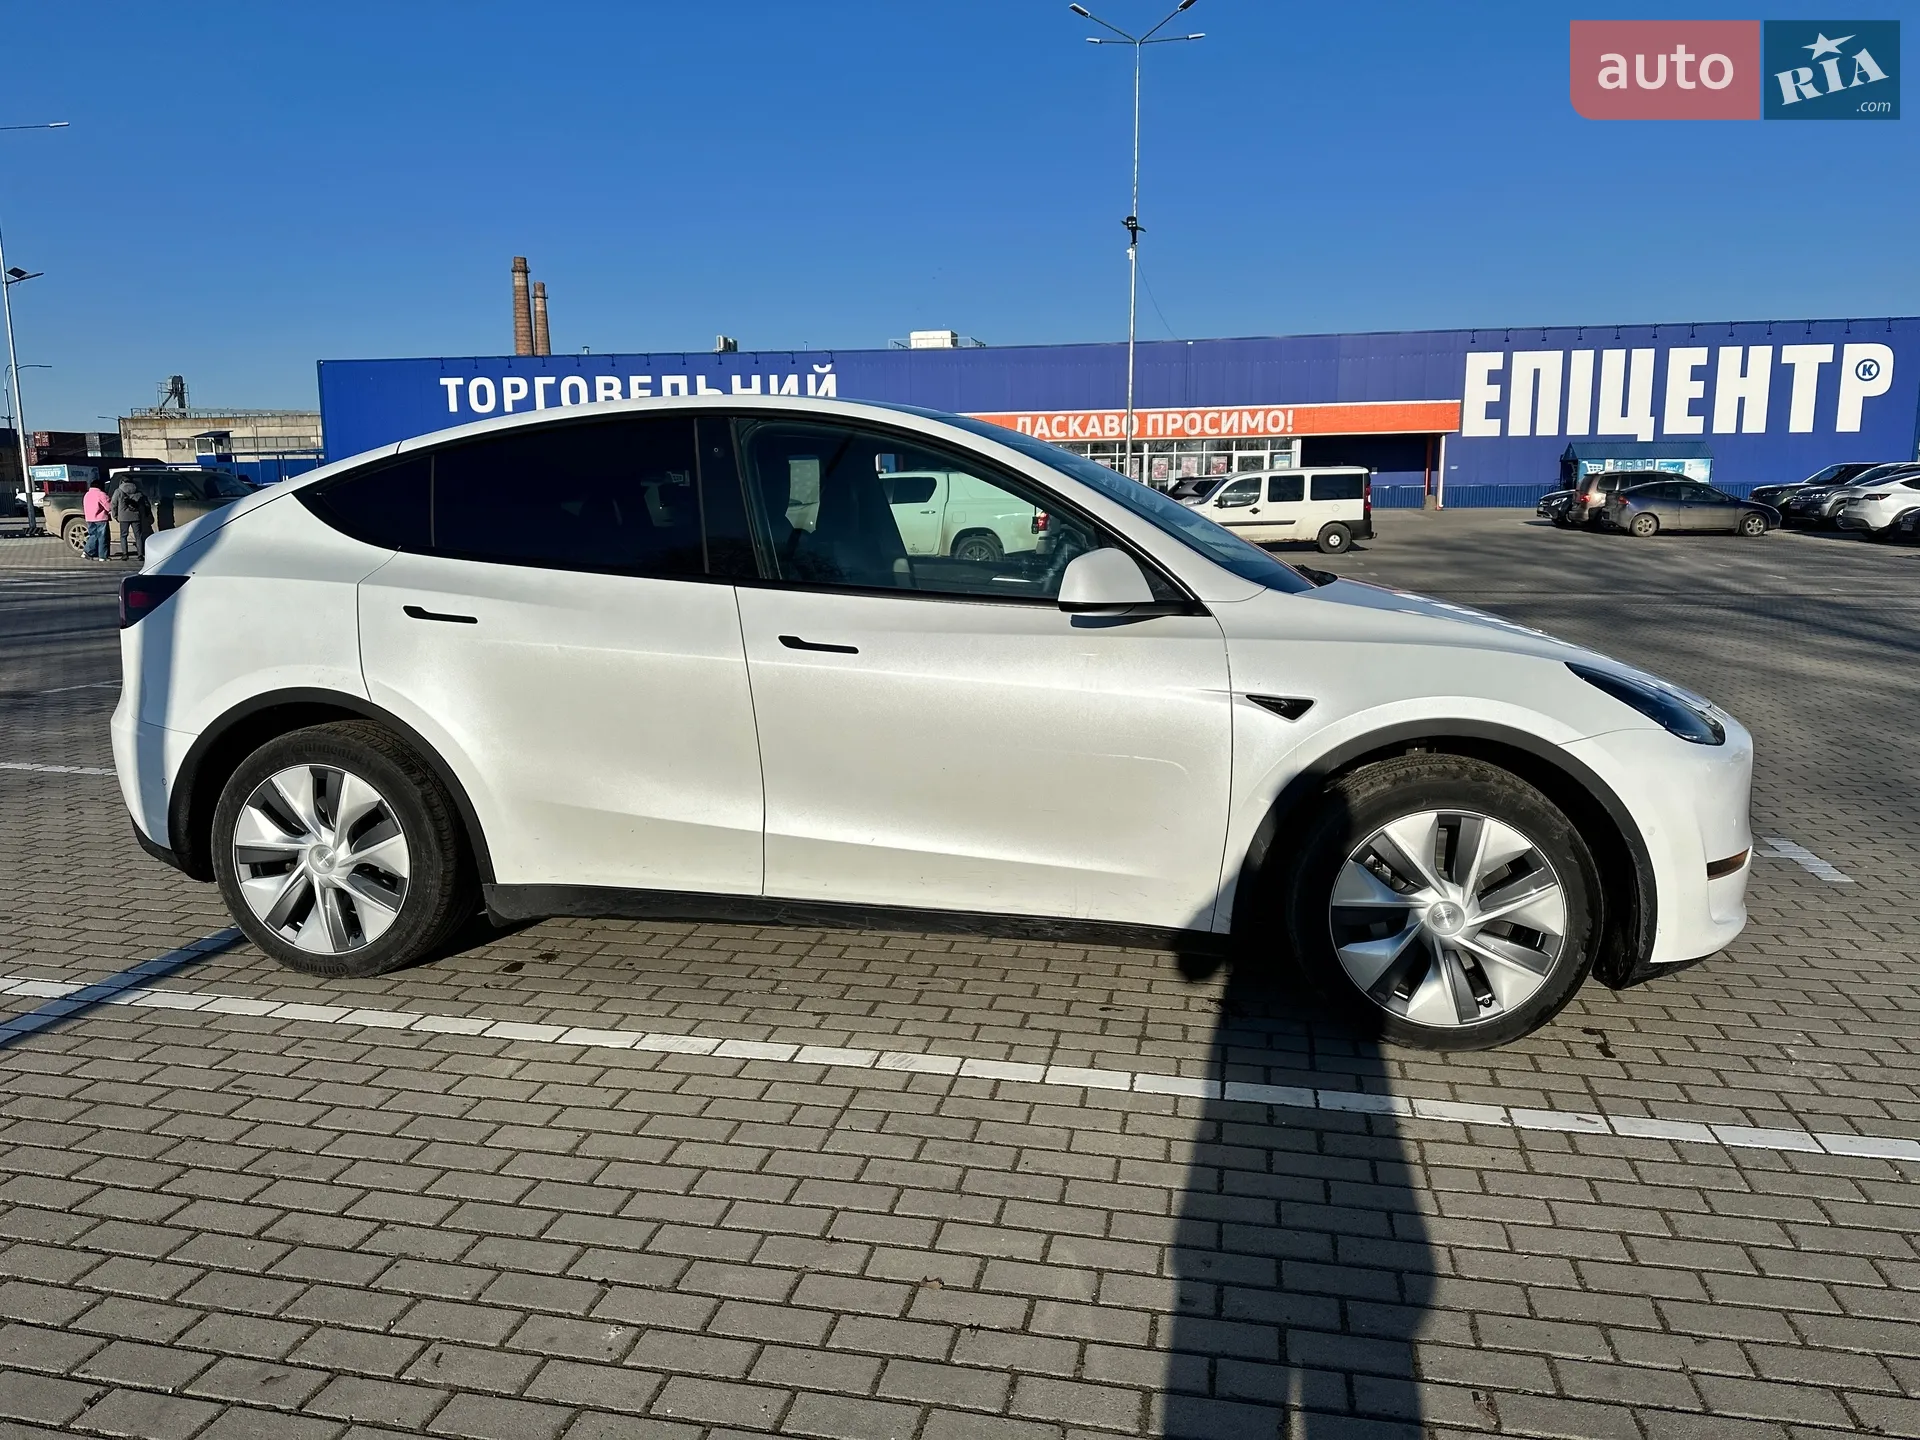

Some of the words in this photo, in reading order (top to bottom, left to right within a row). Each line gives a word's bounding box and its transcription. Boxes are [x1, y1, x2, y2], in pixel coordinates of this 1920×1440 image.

[1016, 414, 1139, 438] ЛАСКАВО
[1146, 409, 1294, 437] ПРОСИМО!
[1461, 343, 1895, 441] ЕПІЦЕНТР
